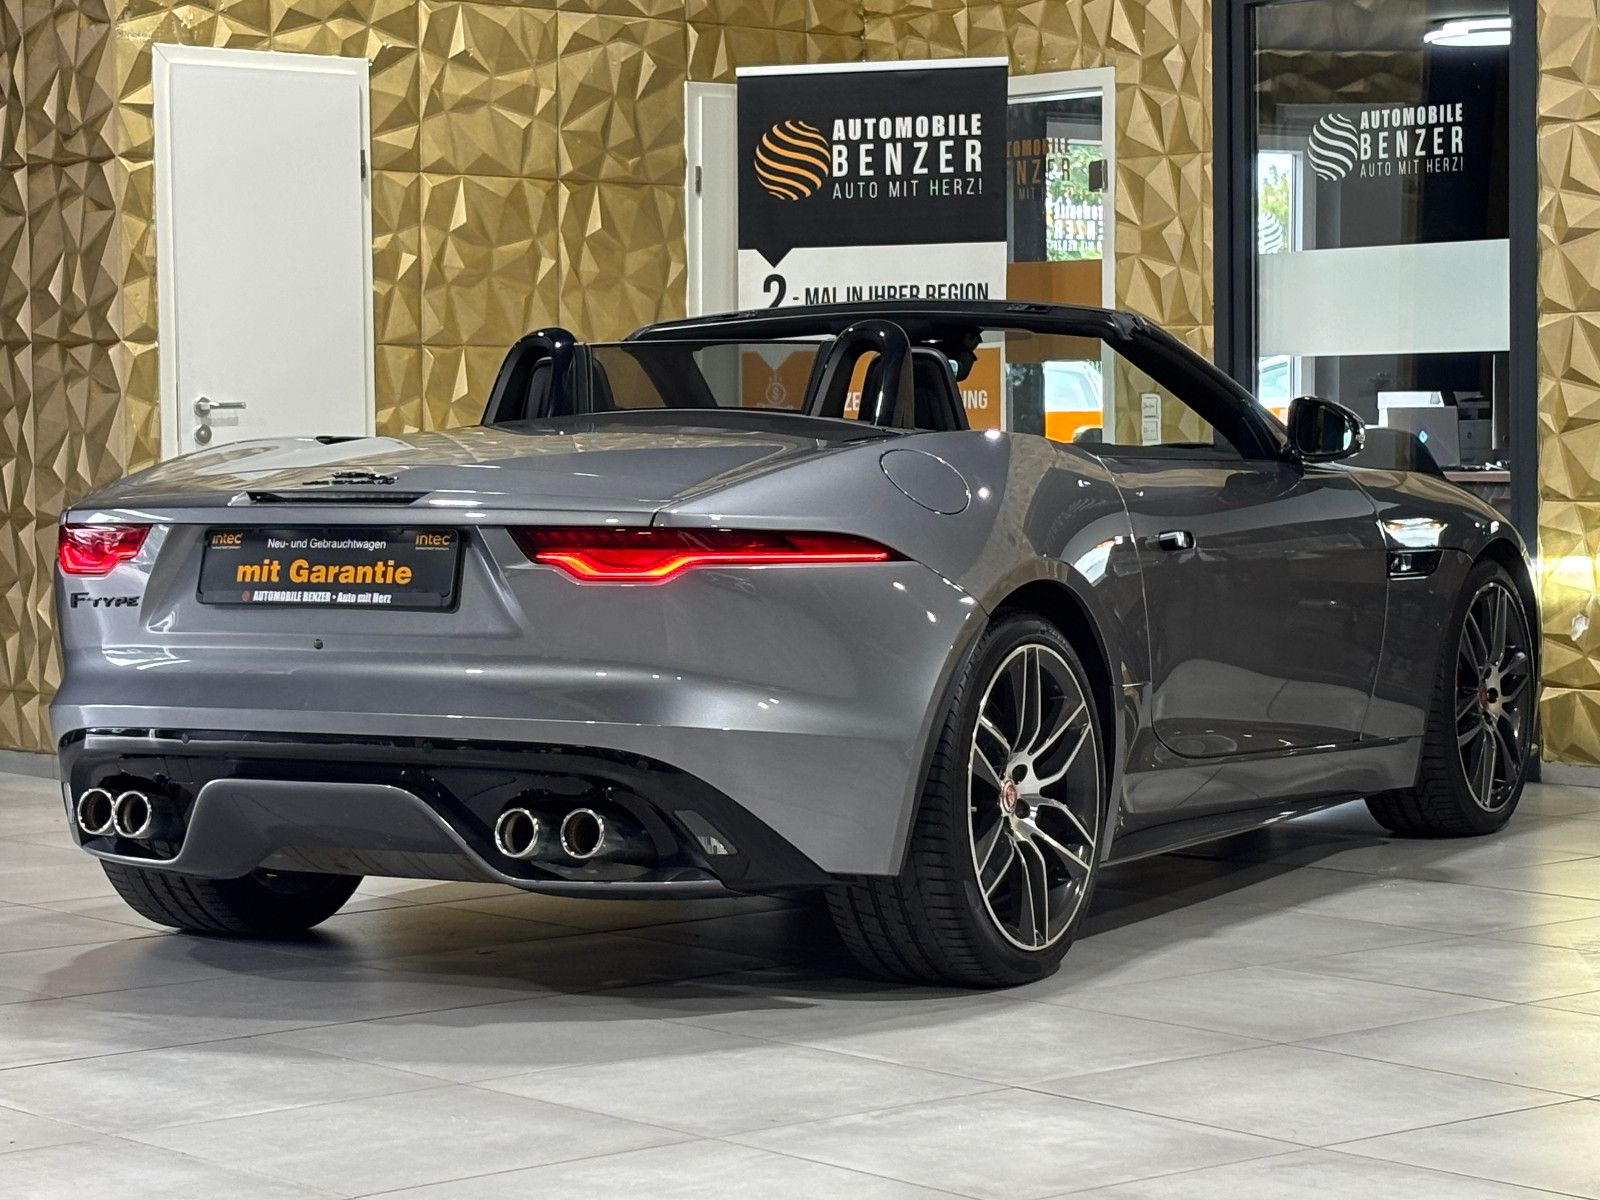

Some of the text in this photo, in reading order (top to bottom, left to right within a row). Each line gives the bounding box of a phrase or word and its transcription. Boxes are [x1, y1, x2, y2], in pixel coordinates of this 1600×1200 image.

[832, 113, 982, 141] AUTOMOBILE
[1360, 103, 1463, 130] AUTOMOBILE
[1360, 125, 1464, 160] BENZER
[832, 139, 982, 178] BENZER
[1360, 156, 1464, 178] AUTO MIT HERZ!
[832, 177, 983, 199] AUTO MIT HERZ!
[804, 286, 837, 306] MAL
[846, 286, 863, 301] IN
[925, 282, 989, 300] REGION
[211, 532, 244, 545] intec
[267, 538, 387, 552] Neu- und Gebrauchtwagen
[415, 533, 451, 546] intec
[236, 558, 413, 585] mit Garantie
[252, 590, 392, 604] AUTOMOBILE BENZER Auto mit Herz
